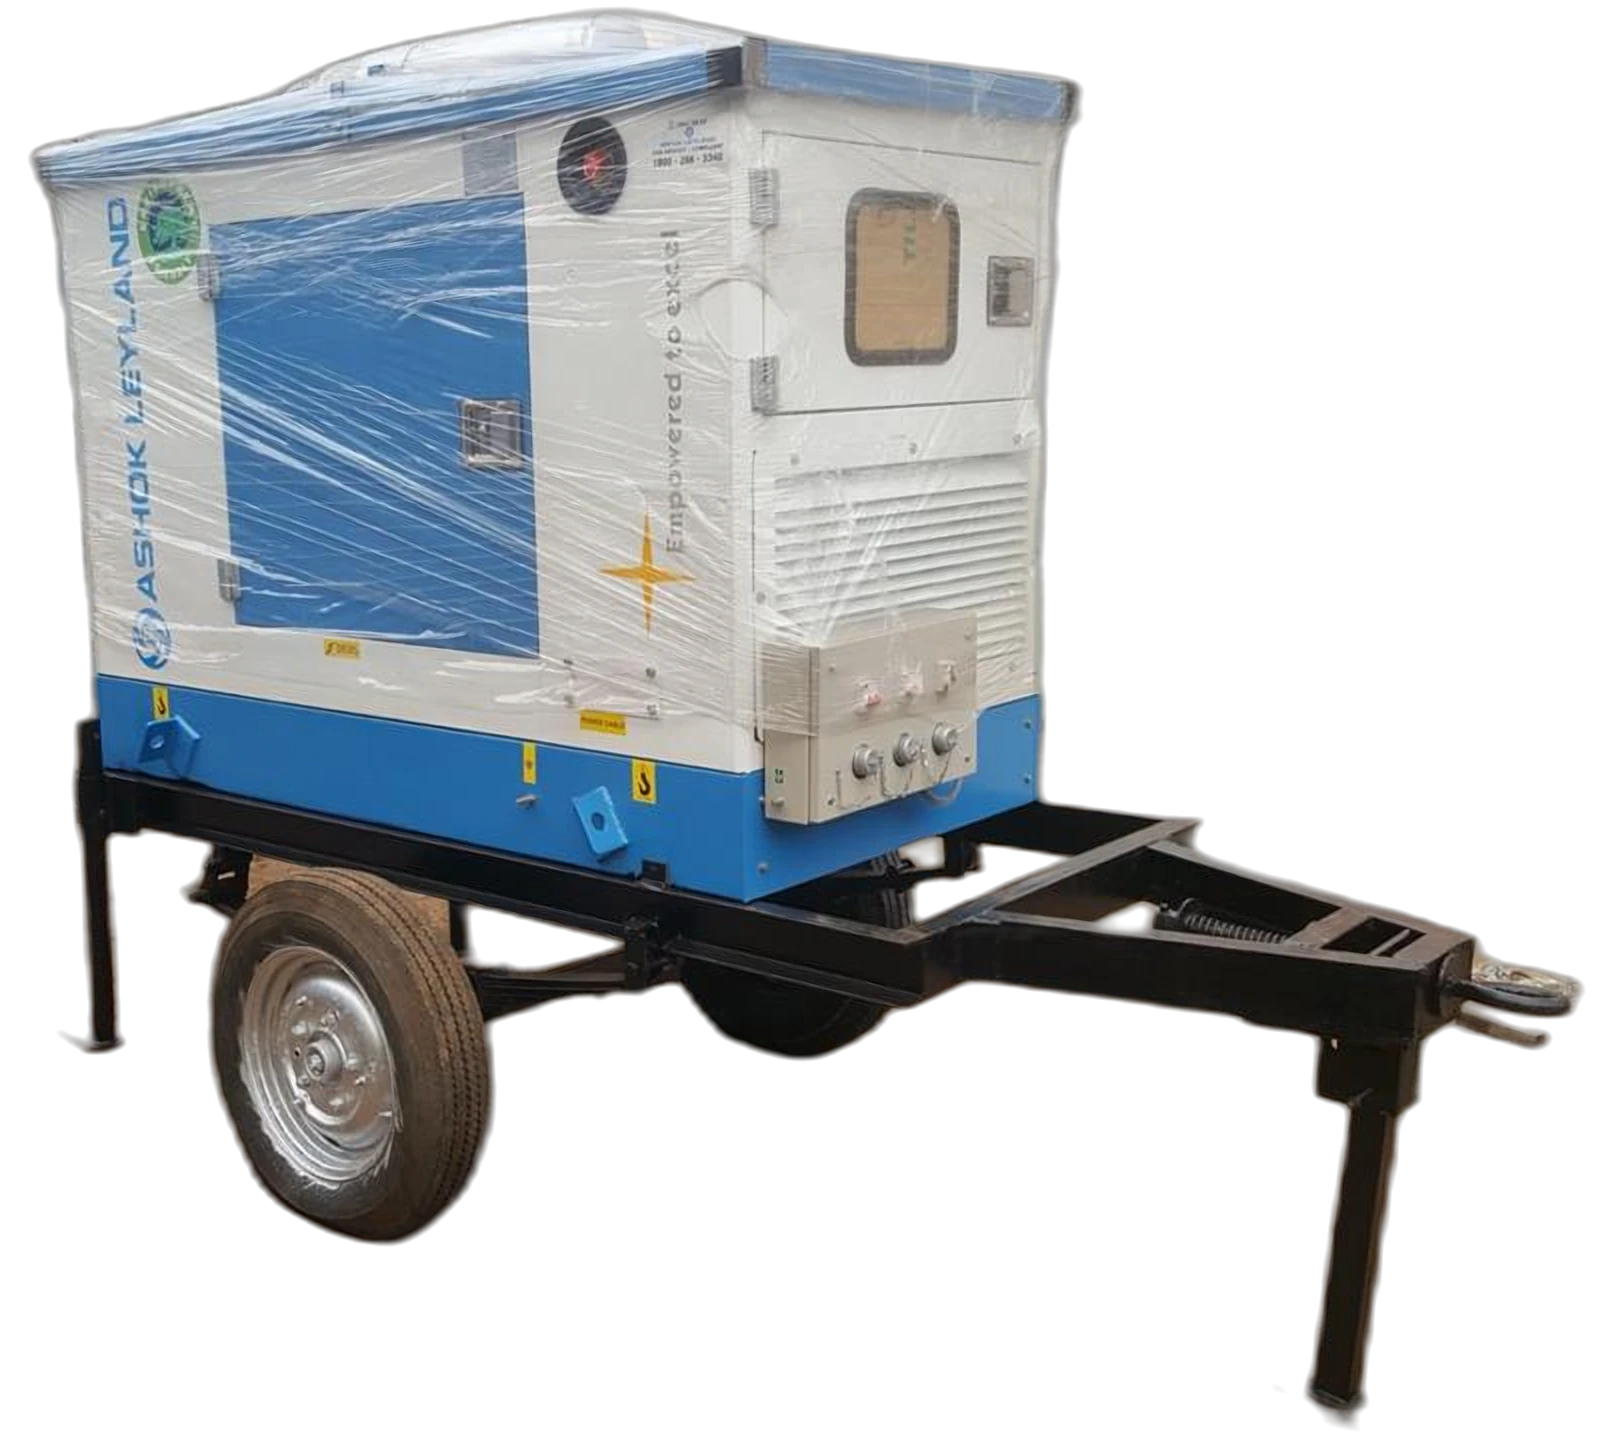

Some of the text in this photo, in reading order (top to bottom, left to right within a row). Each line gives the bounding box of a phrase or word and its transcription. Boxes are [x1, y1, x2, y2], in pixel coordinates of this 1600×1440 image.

[107, 197, 158, 602] ASHOK LEYLAND
[660, 229, 686, 553] Empowered to excel
